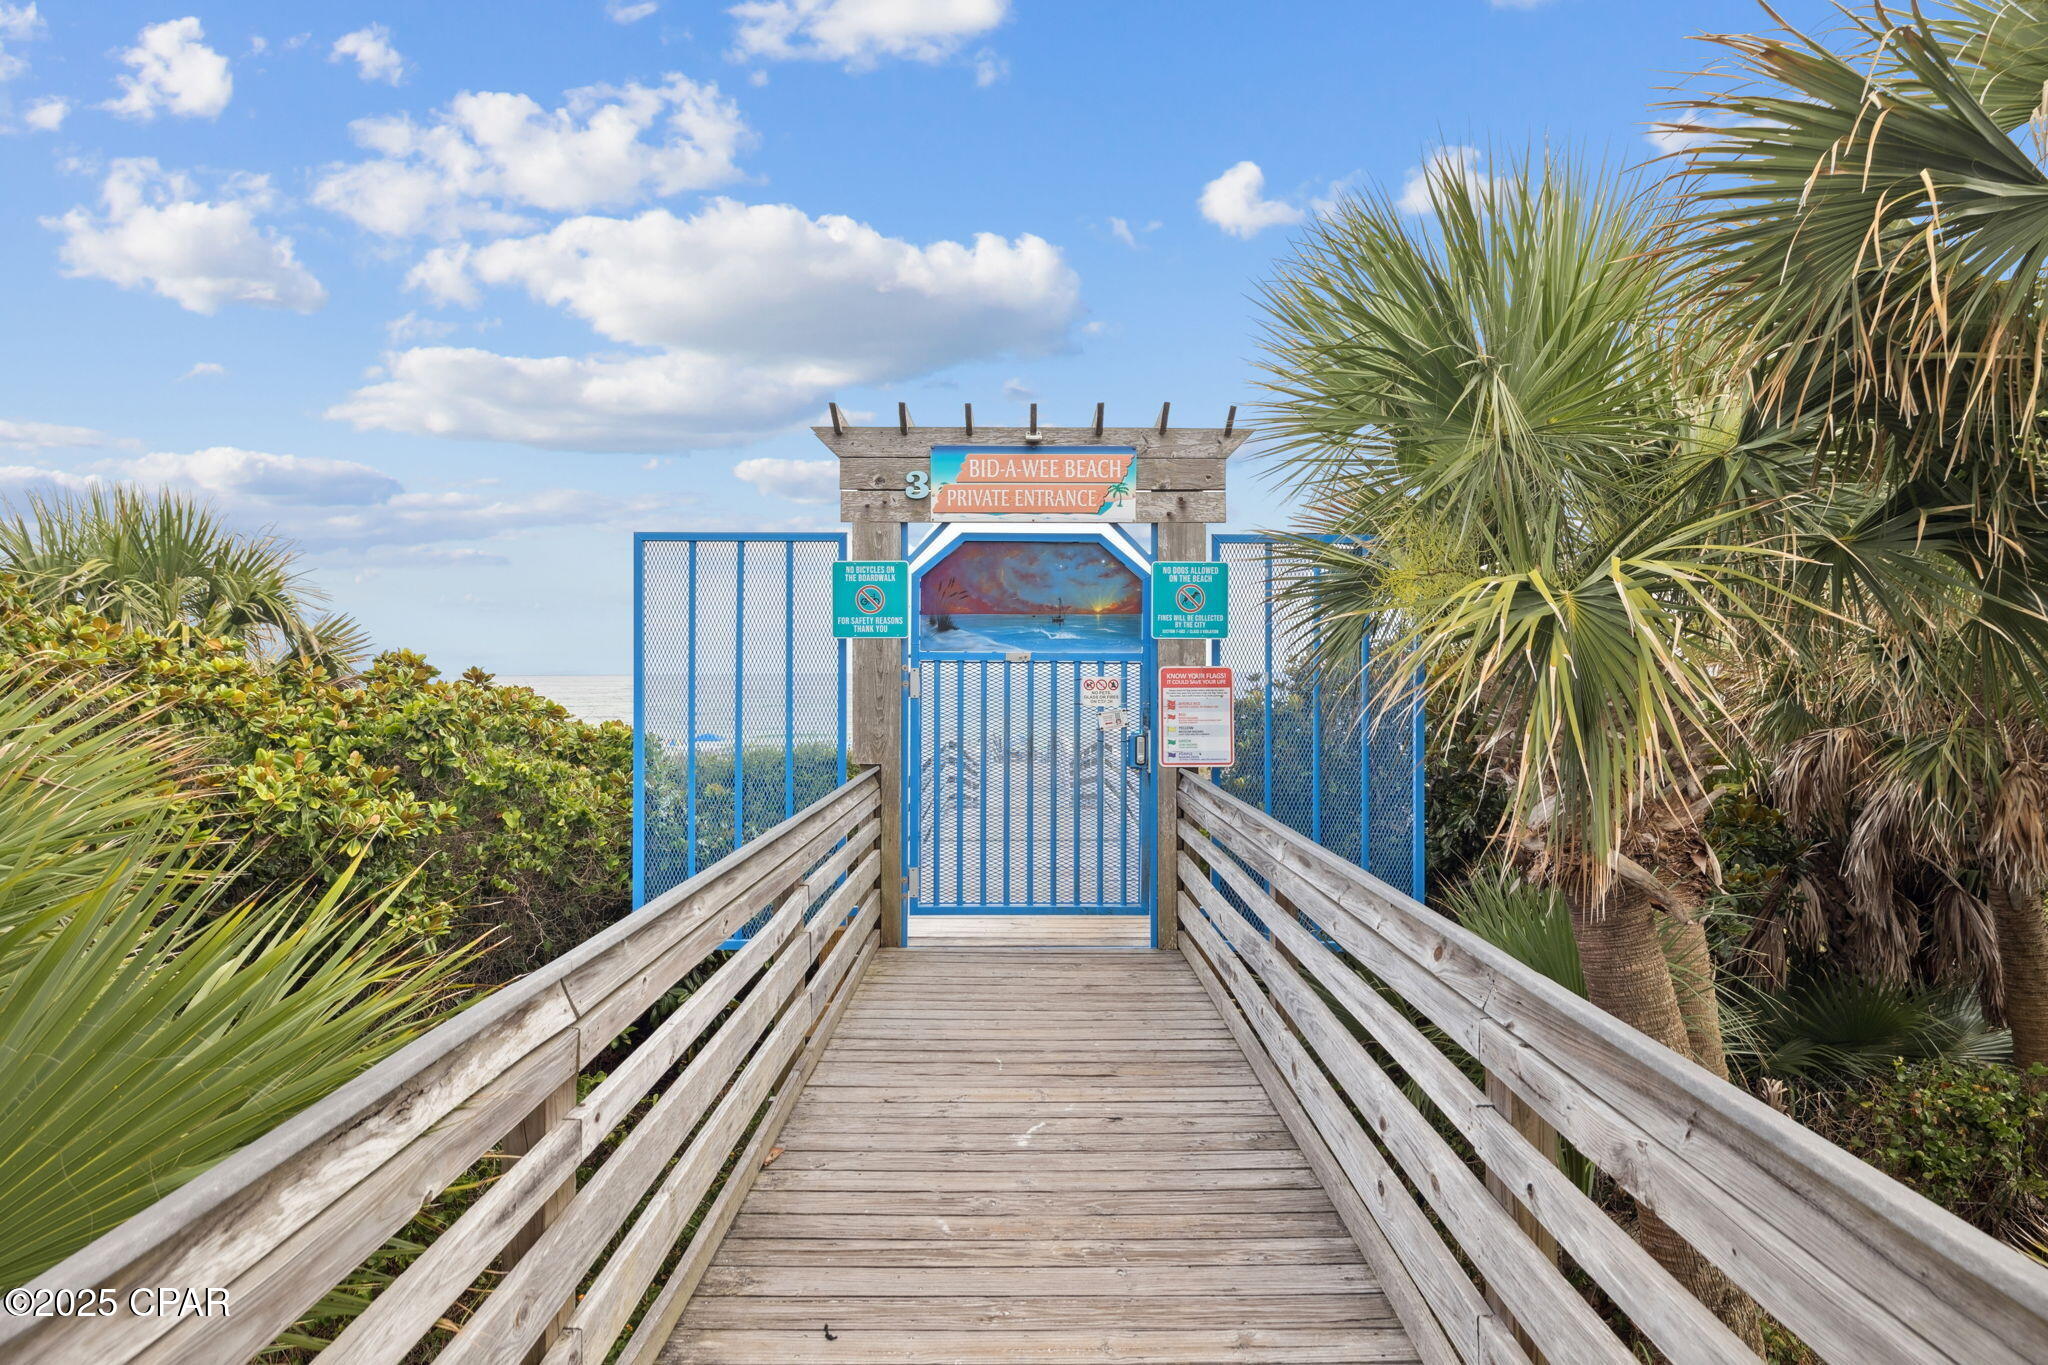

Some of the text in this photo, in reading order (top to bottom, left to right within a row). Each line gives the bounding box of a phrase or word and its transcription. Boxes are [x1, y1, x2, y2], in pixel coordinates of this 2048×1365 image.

[969, 459, 1122, 478] BID-A-WEE BEACH
[905, 470, 930, 499] 3
[947, 489, 1097, 507] PRIVATE ENTRANCE
